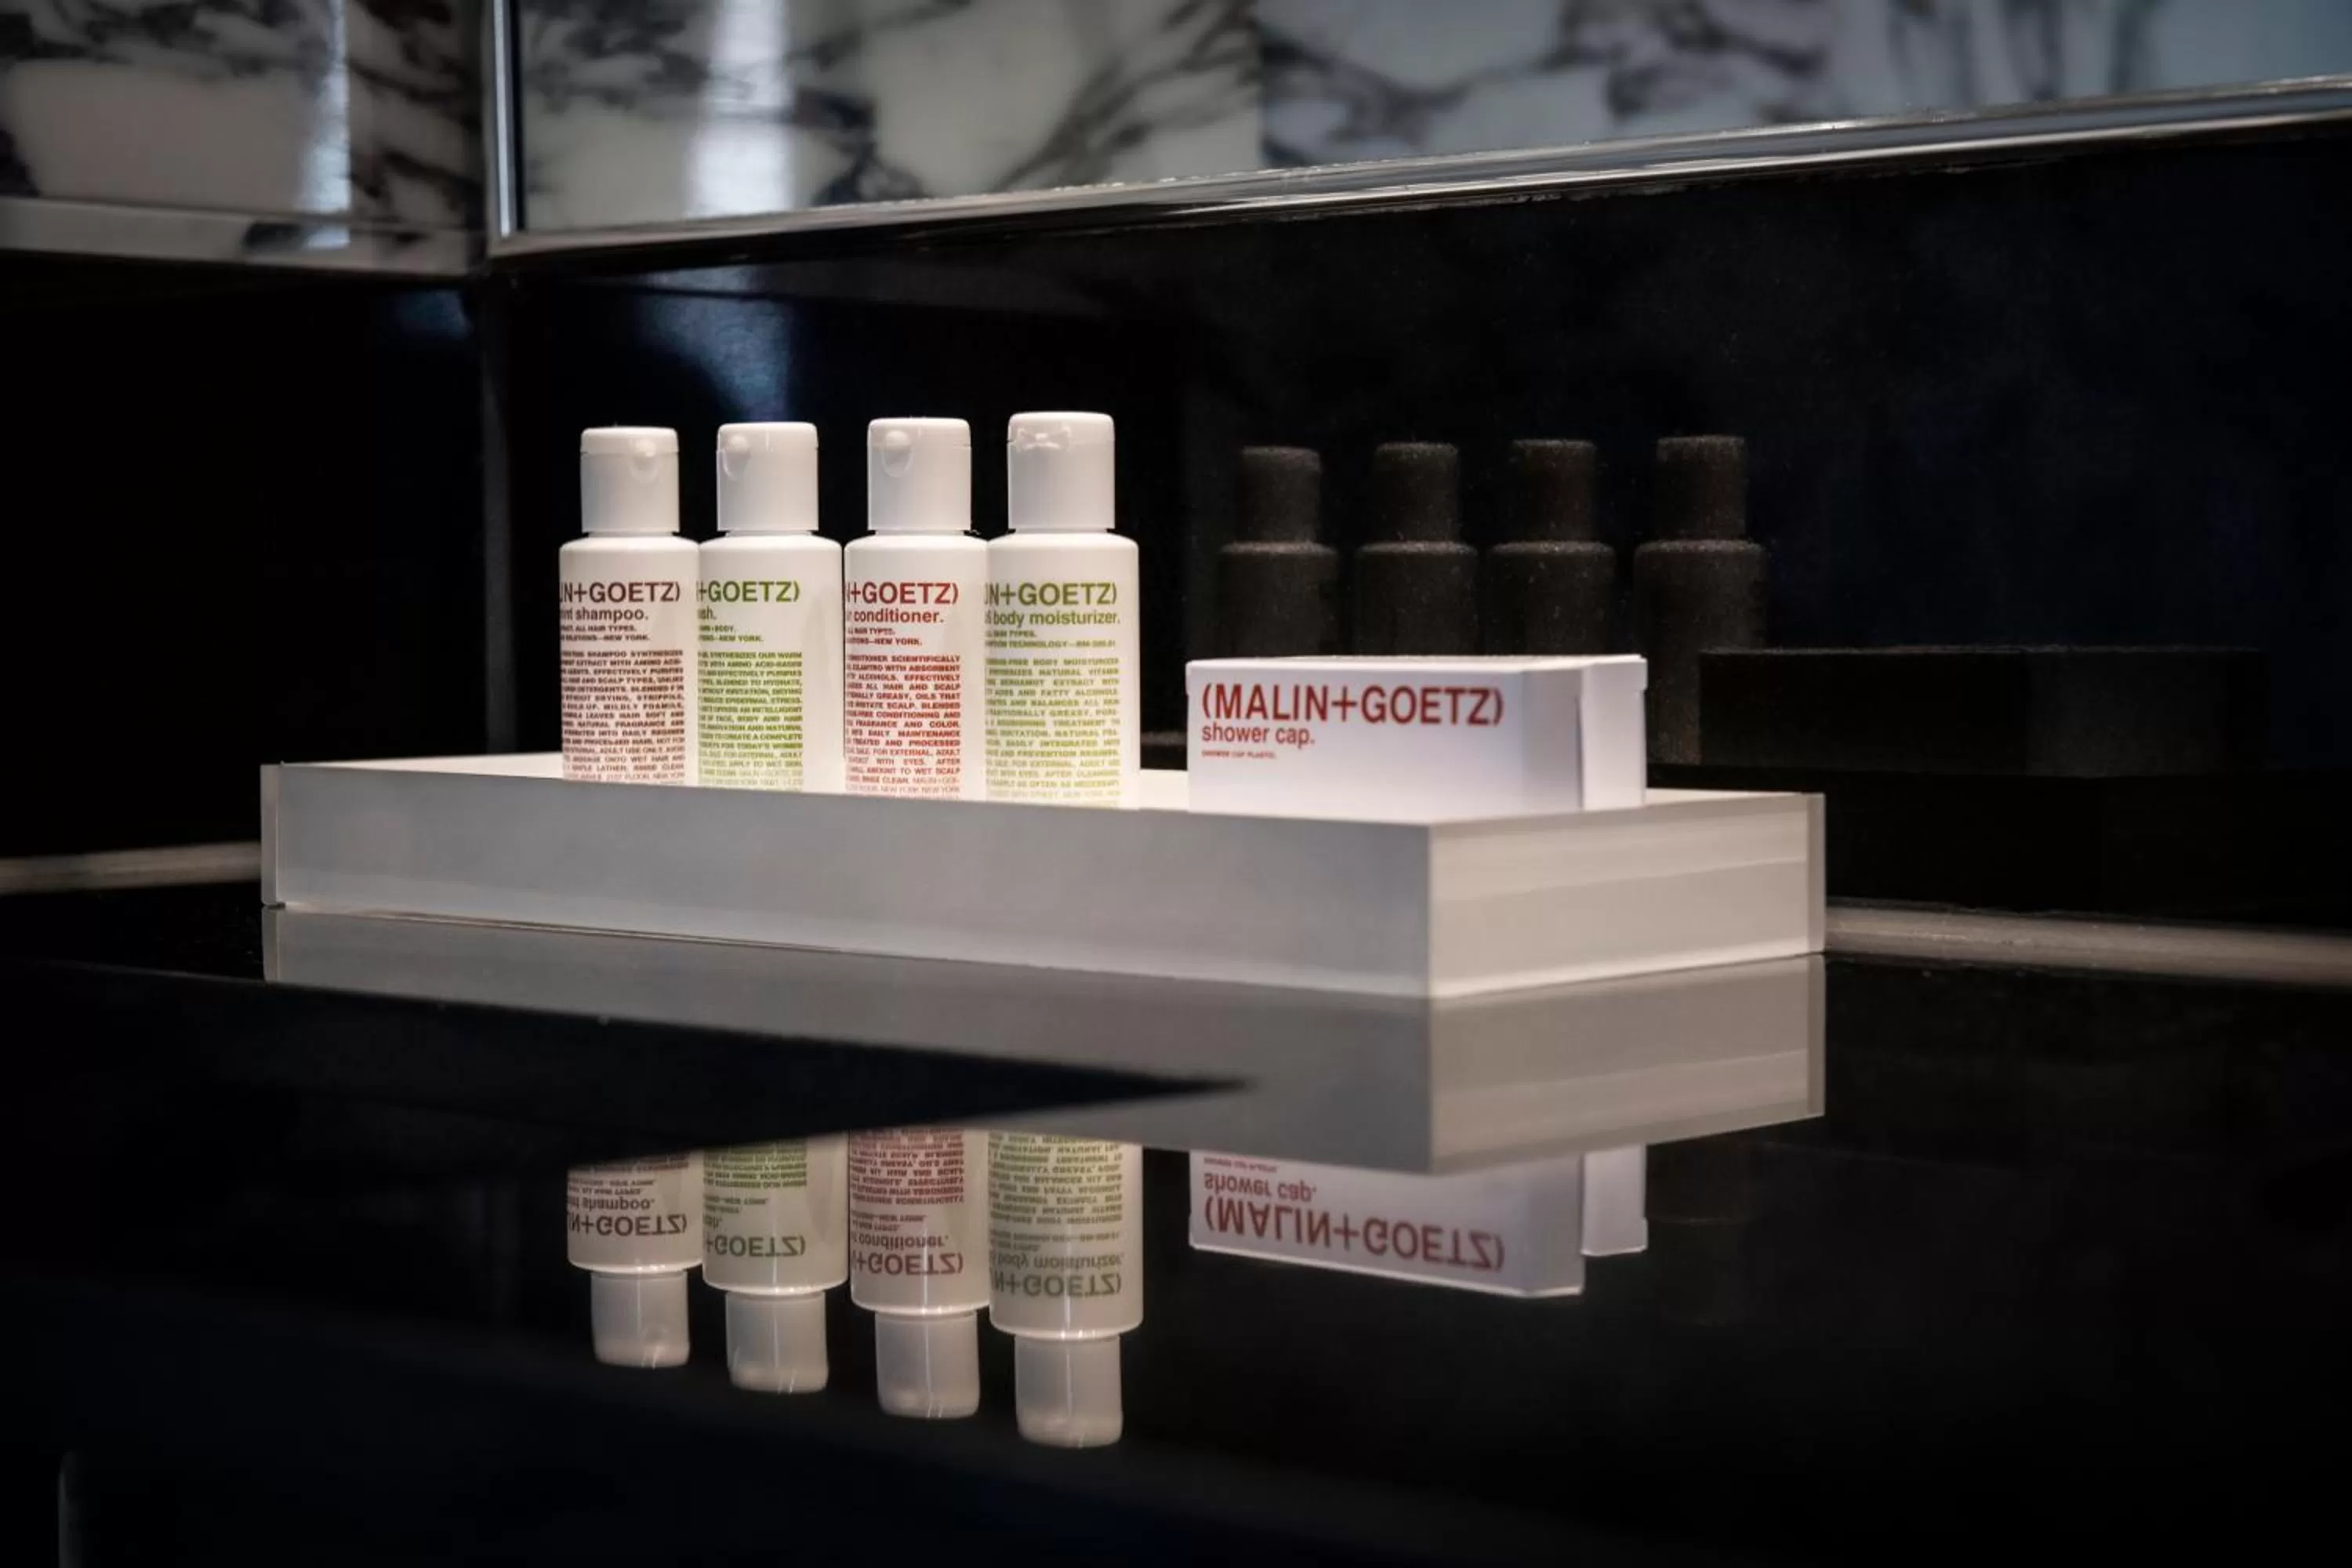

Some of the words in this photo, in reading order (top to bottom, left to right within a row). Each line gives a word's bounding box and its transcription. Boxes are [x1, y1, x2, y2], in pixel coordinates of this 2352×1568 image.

[560, 581, 680, 603] IN+GOETZ)
[984, 582, 1117, 606] IN+GOETZ)
[575, 606, 649, 624] shampoo.
[853, 608, 945, 623] conditioner.
[993, 610, 1025, 628] body
[1029, 609, 1121, 626] moisturizer.
[1201, 683, 1505, 727] (MALIN+GOETZ)
[1201, 722, 1269, 744] shower
[1275, 728, 1316, 750] cap.
